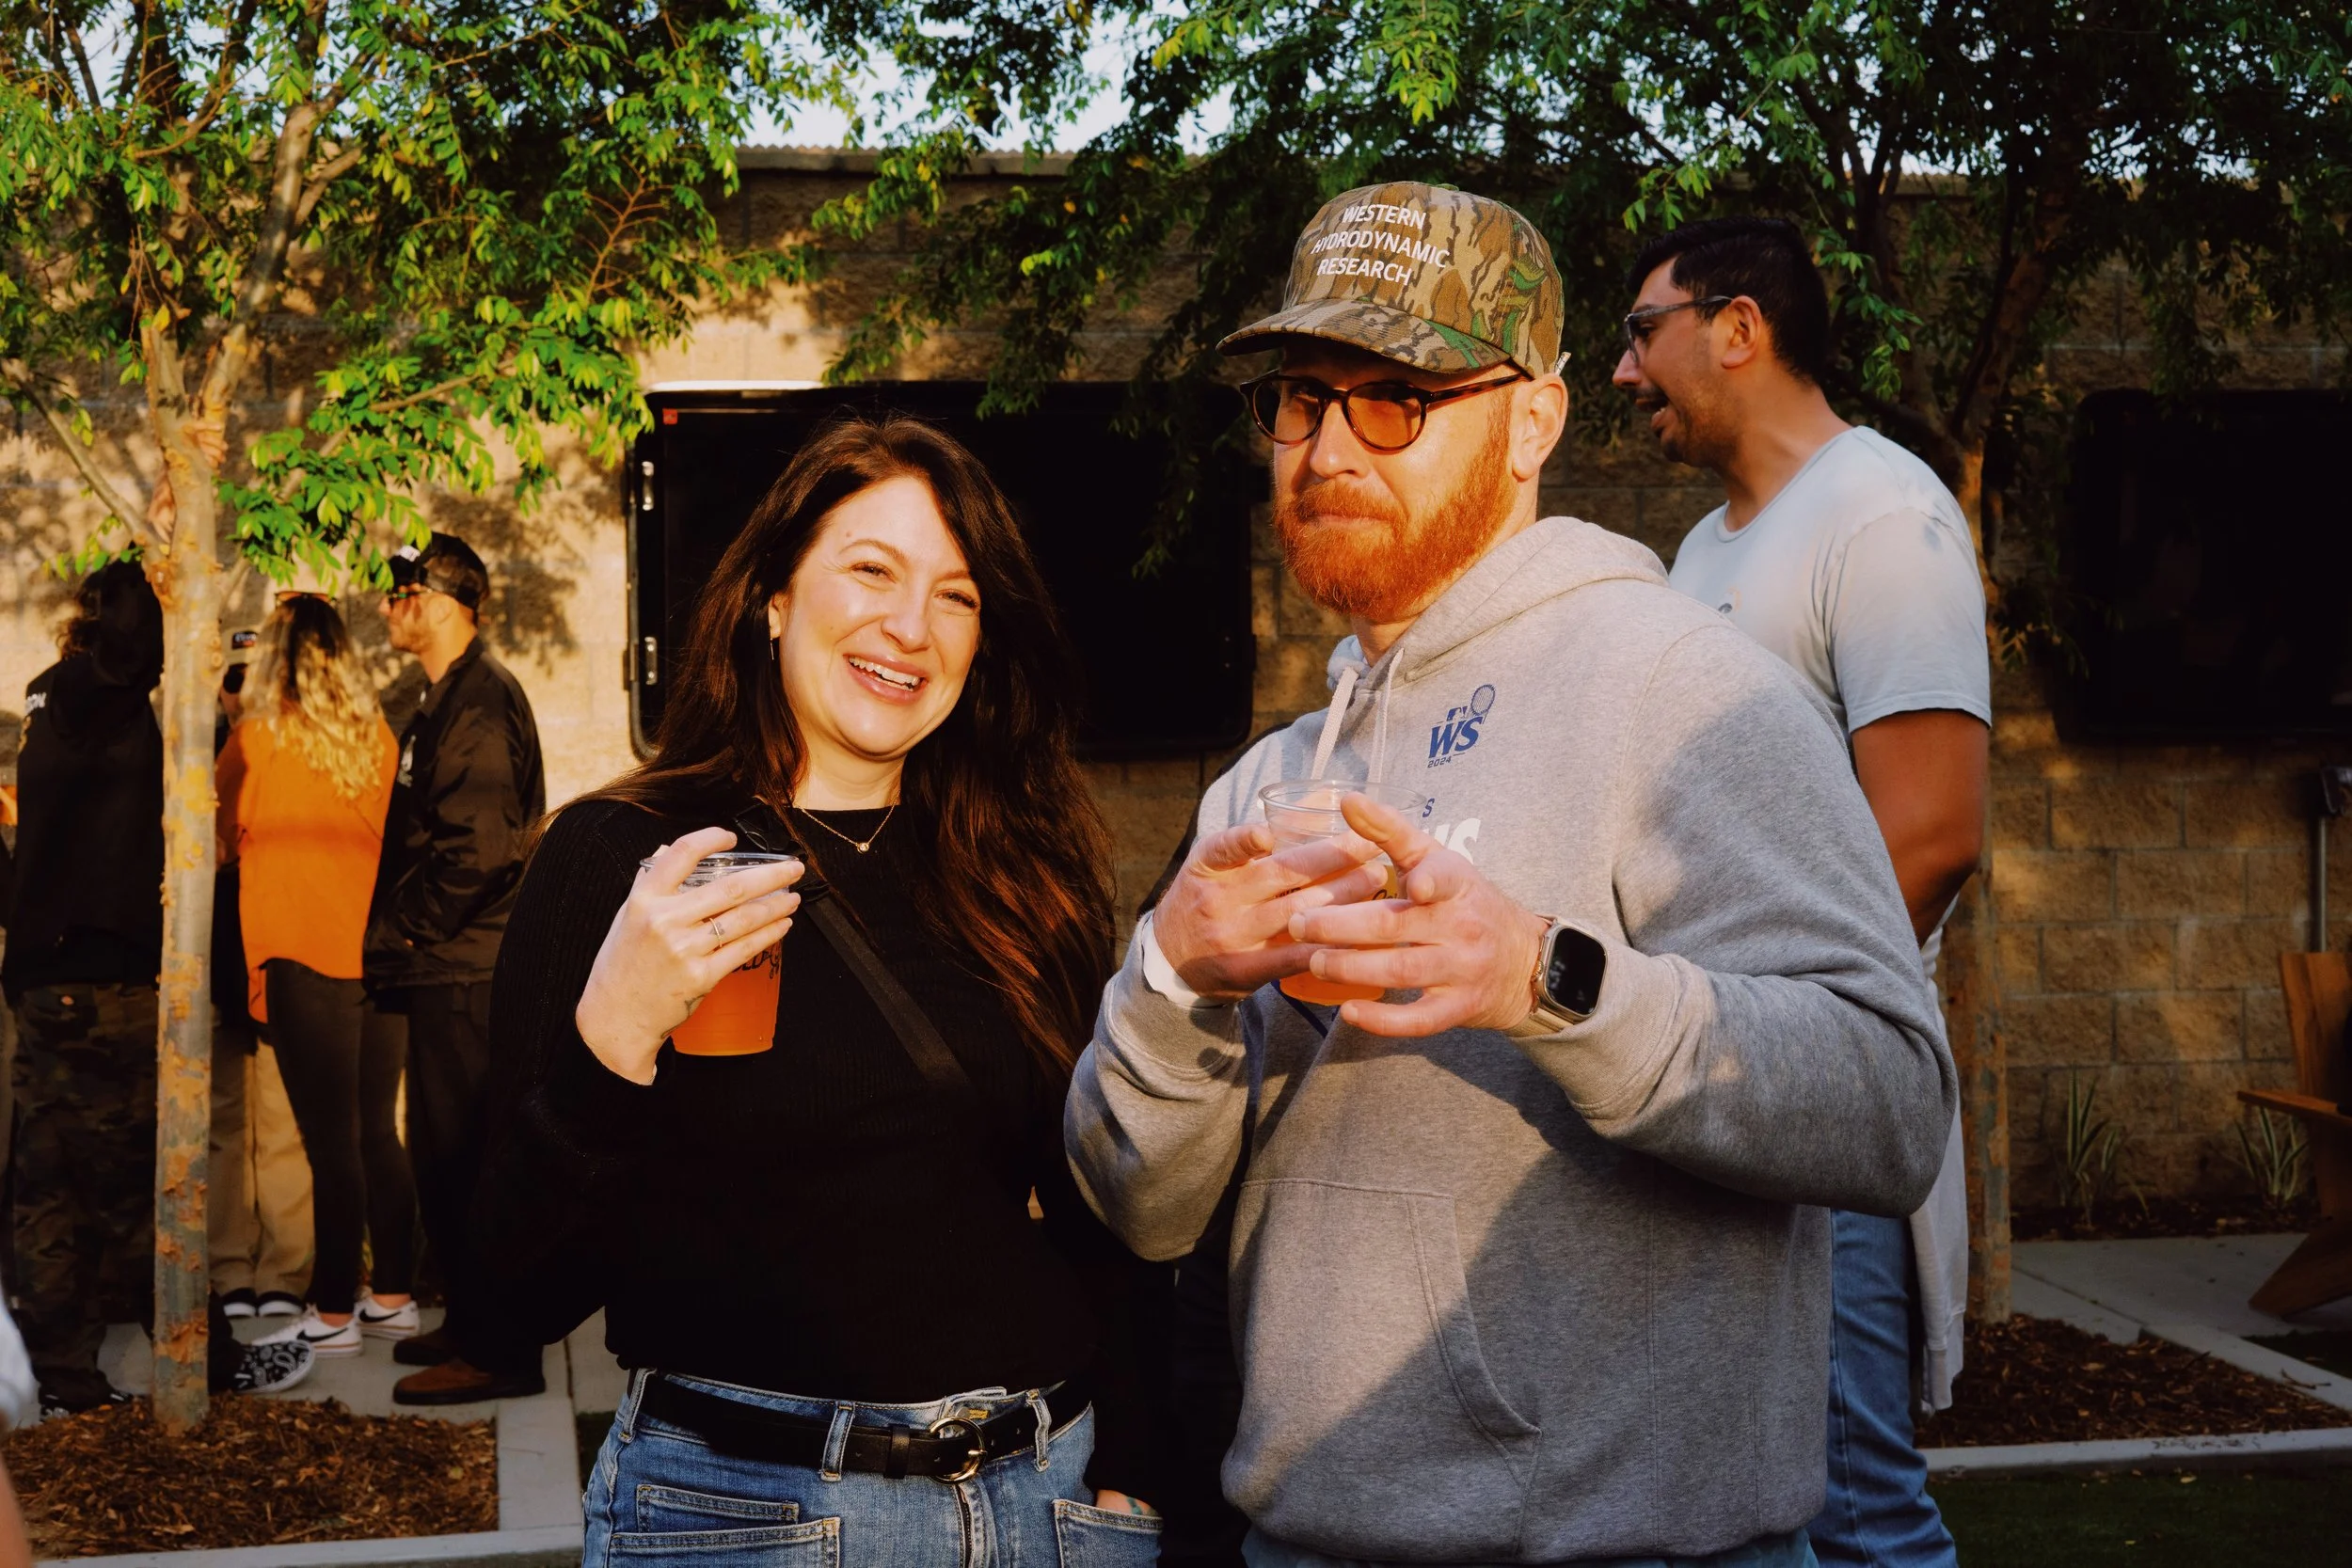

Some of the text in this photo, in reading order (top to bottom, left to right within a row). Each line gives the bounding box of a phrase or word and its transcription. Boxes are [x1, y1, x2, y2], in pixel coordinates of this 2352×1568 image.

[1342, 204, 1426, 230] WESTERN
[1311, 230, 1450, 268] HYDRODYNAMIC
[1317, 257, 1412, 286] RESEARCH
[1428, 716, 1484, 758] WS
[1427, 756, 1452, 768] 2024
